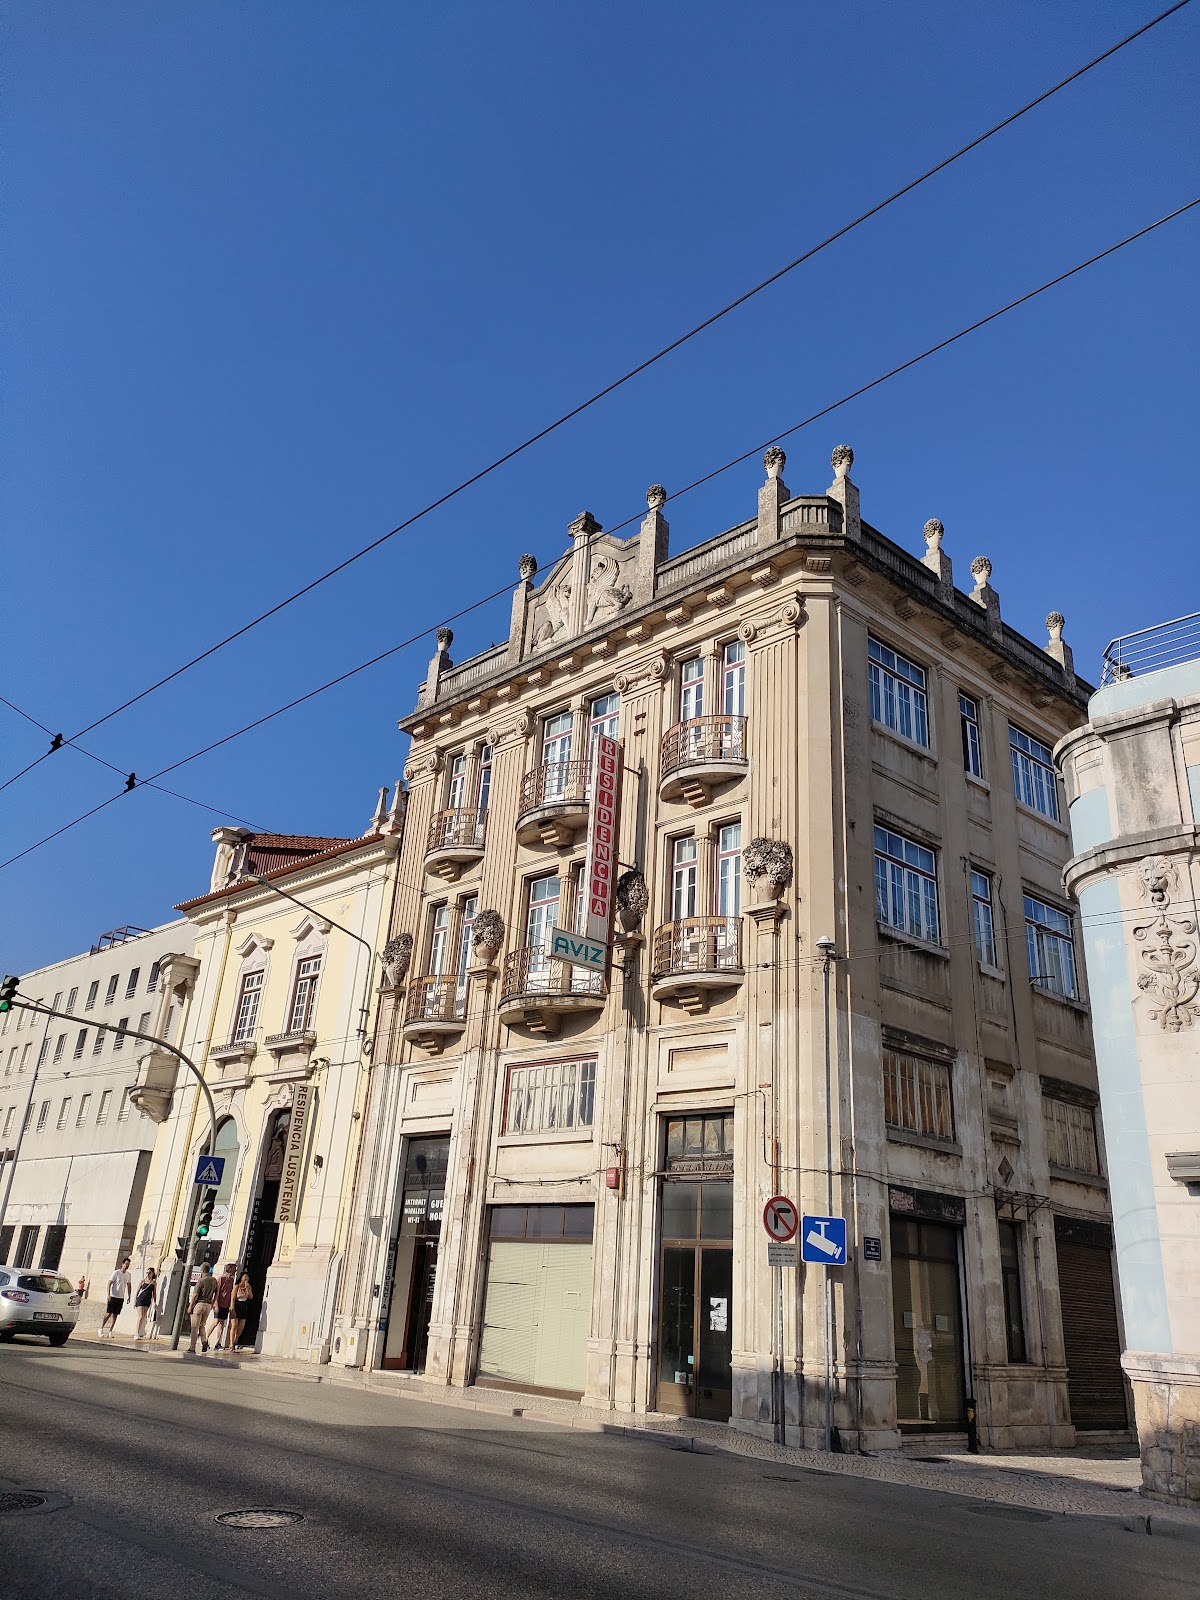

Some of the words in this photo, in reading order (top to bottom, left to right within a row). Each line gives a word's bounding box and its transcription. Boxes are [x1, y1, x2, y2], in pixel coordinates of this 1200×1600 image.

[593, 738, 616, 917] RESIDENCIA
[554, 936, 603, 964] AVIZ
[289, 1086, 307, 1150] RESIDENCIA
[279, 1154, 300, 1222] LUSATENAS
[430, 1200, 443, 1209] GUE
